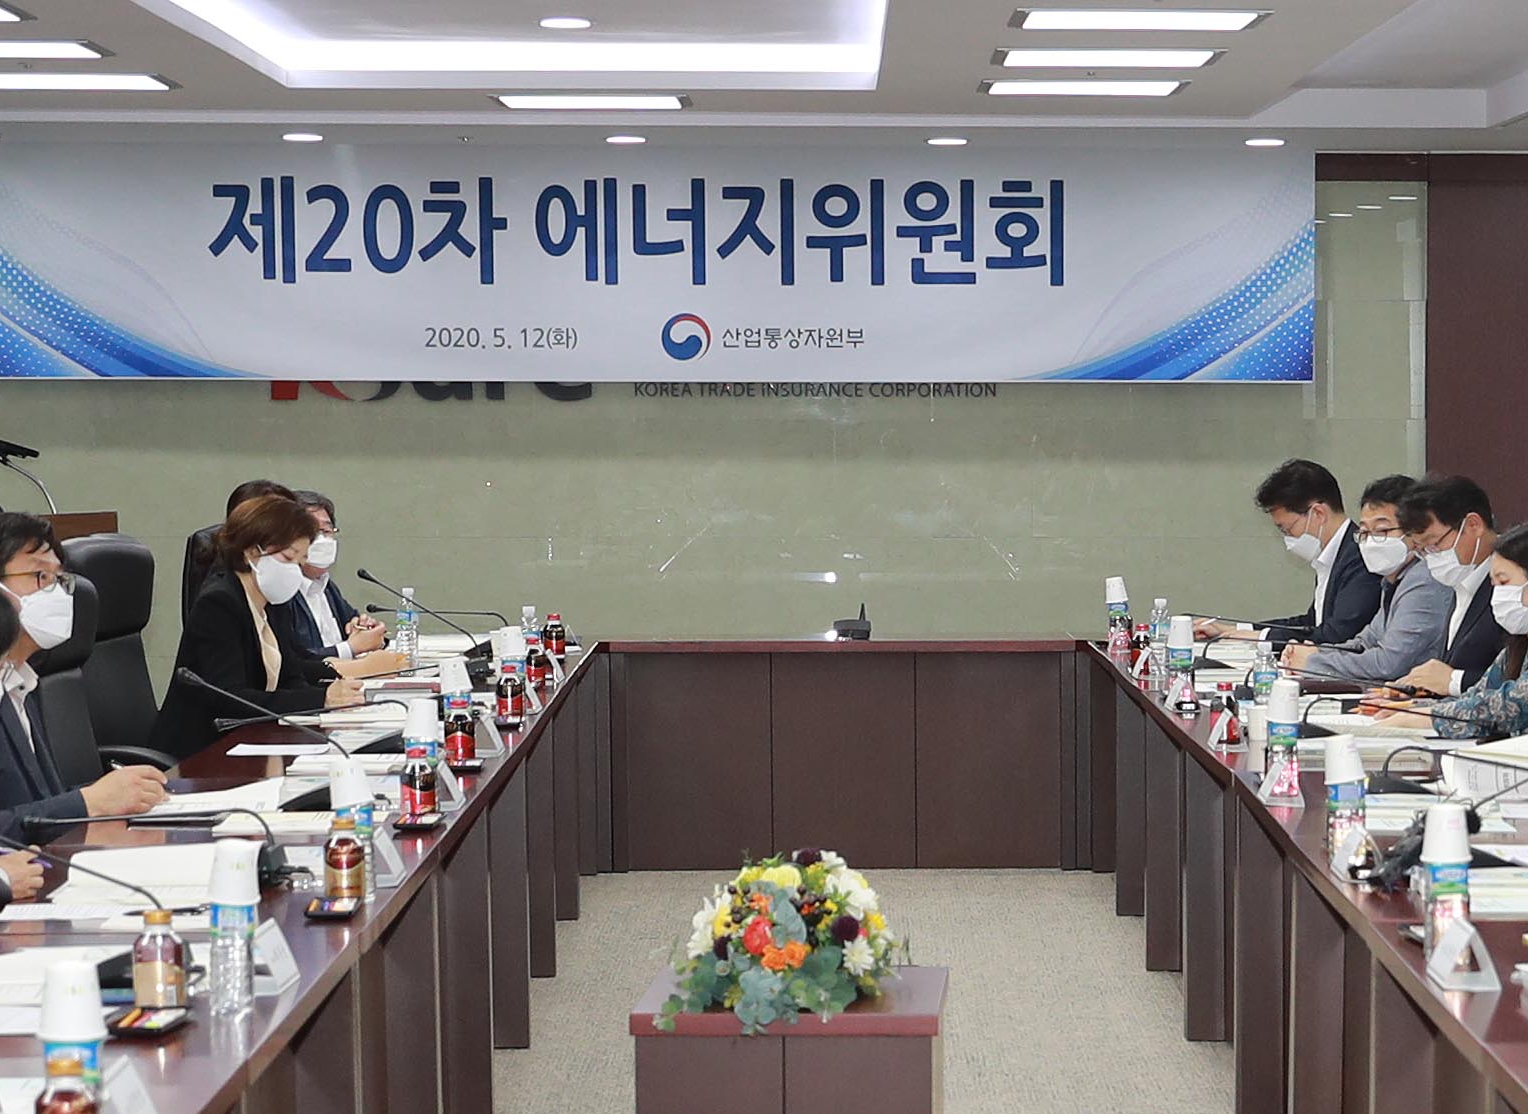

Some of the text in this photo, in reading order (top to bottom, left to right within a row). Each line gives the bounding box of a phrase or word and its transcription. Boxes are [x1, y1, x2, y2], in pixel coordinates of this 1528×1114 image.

[208, 175, 1065, 287] 제20차 에너지위원회
[424, 326, 578, 351] 2020. 5. 12(화)
[721, 326, 866, 351] 산업통상자원부
[633, 382, 998, 398] KOREA TRADE INSURANCE CORPORATION
